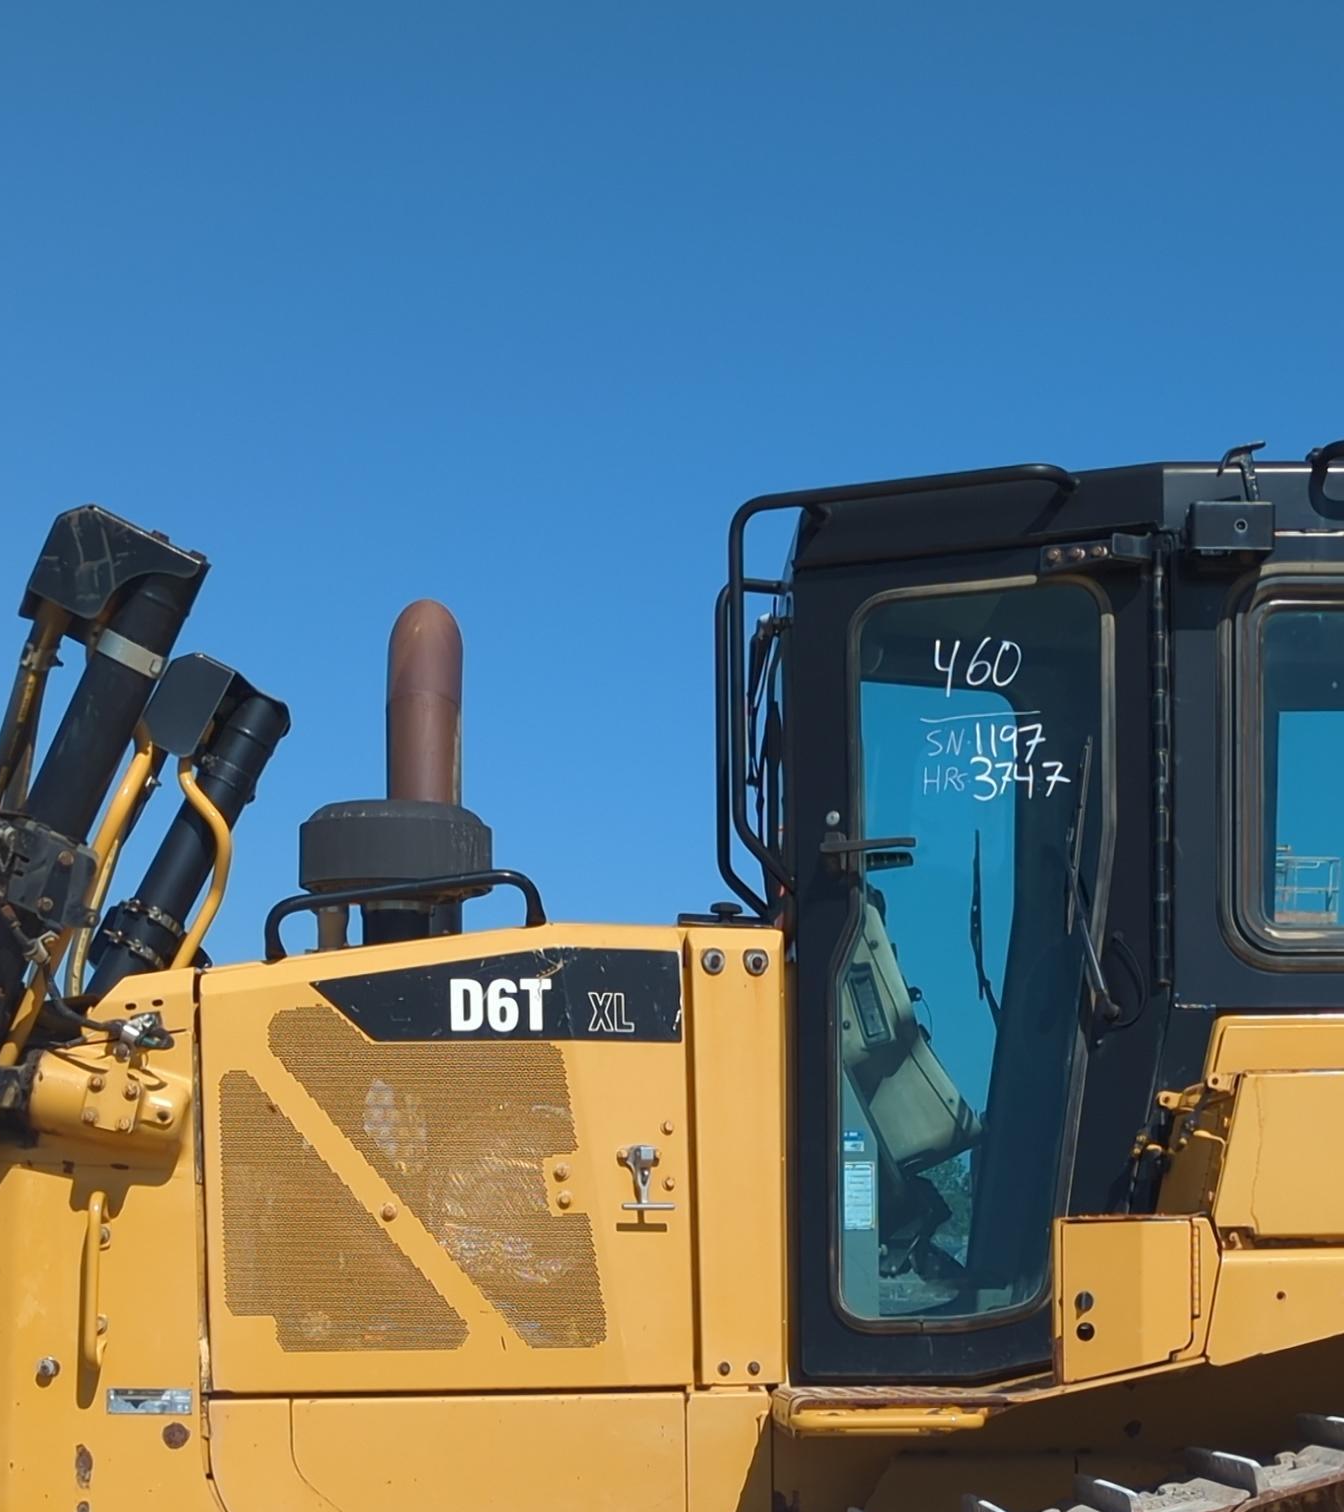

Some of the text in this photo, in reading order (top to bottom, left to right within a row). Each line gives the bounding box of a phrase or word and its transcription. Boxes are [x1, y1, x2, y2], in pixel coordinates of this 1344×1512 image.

[934, 636, 1022, 698] 460
[975, 721, 1046, 763] 1197
[970, 756, 1071, 801] 3747
[449, 978, 635, 1033] D6T XL
